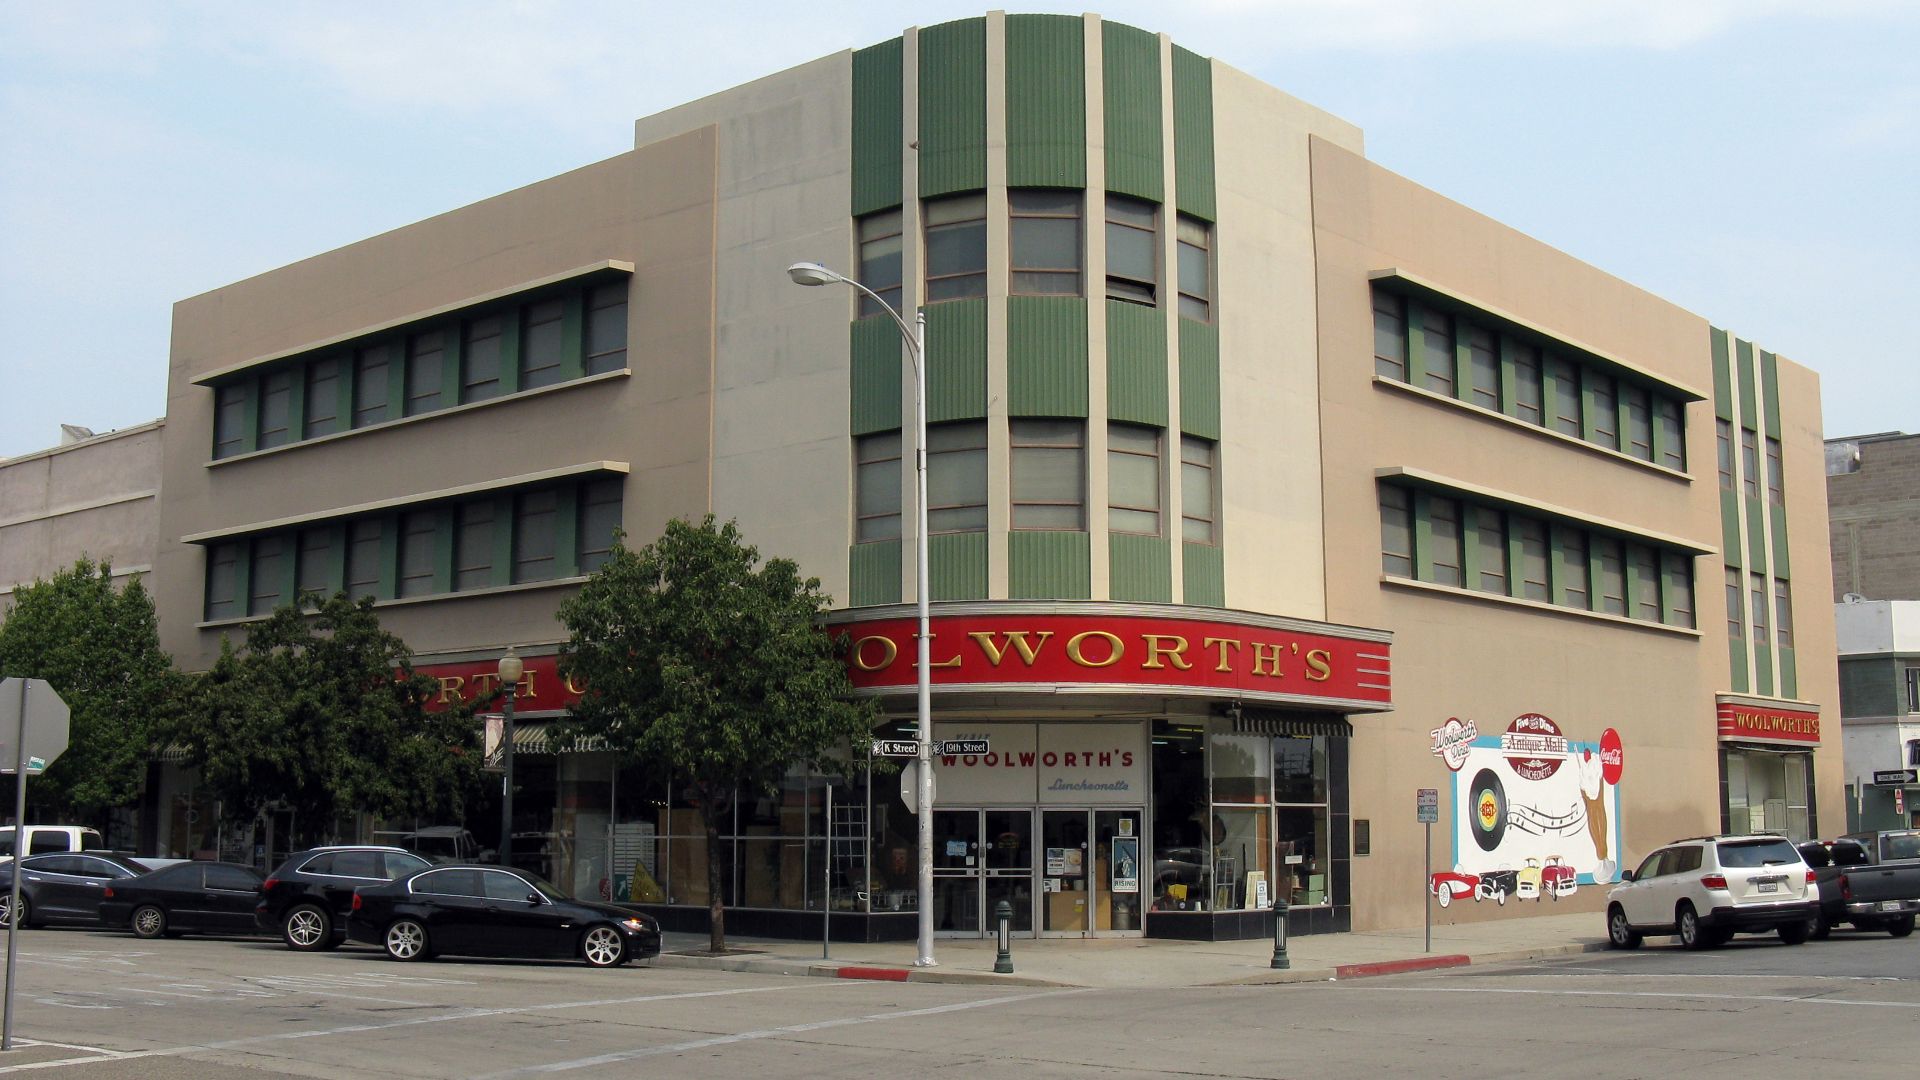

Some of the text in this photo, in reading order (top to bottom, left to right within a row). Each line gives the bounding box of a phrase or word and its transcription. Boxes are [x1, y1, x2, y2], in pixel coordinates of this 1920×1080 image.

[884, 743, 917, 753] K Street
[945, 742, 986, 753] 19th Street
[941, 749, 1133, 767] WOOLWORTH'S
[1048, 778, 1129, 791] Luncheonette
